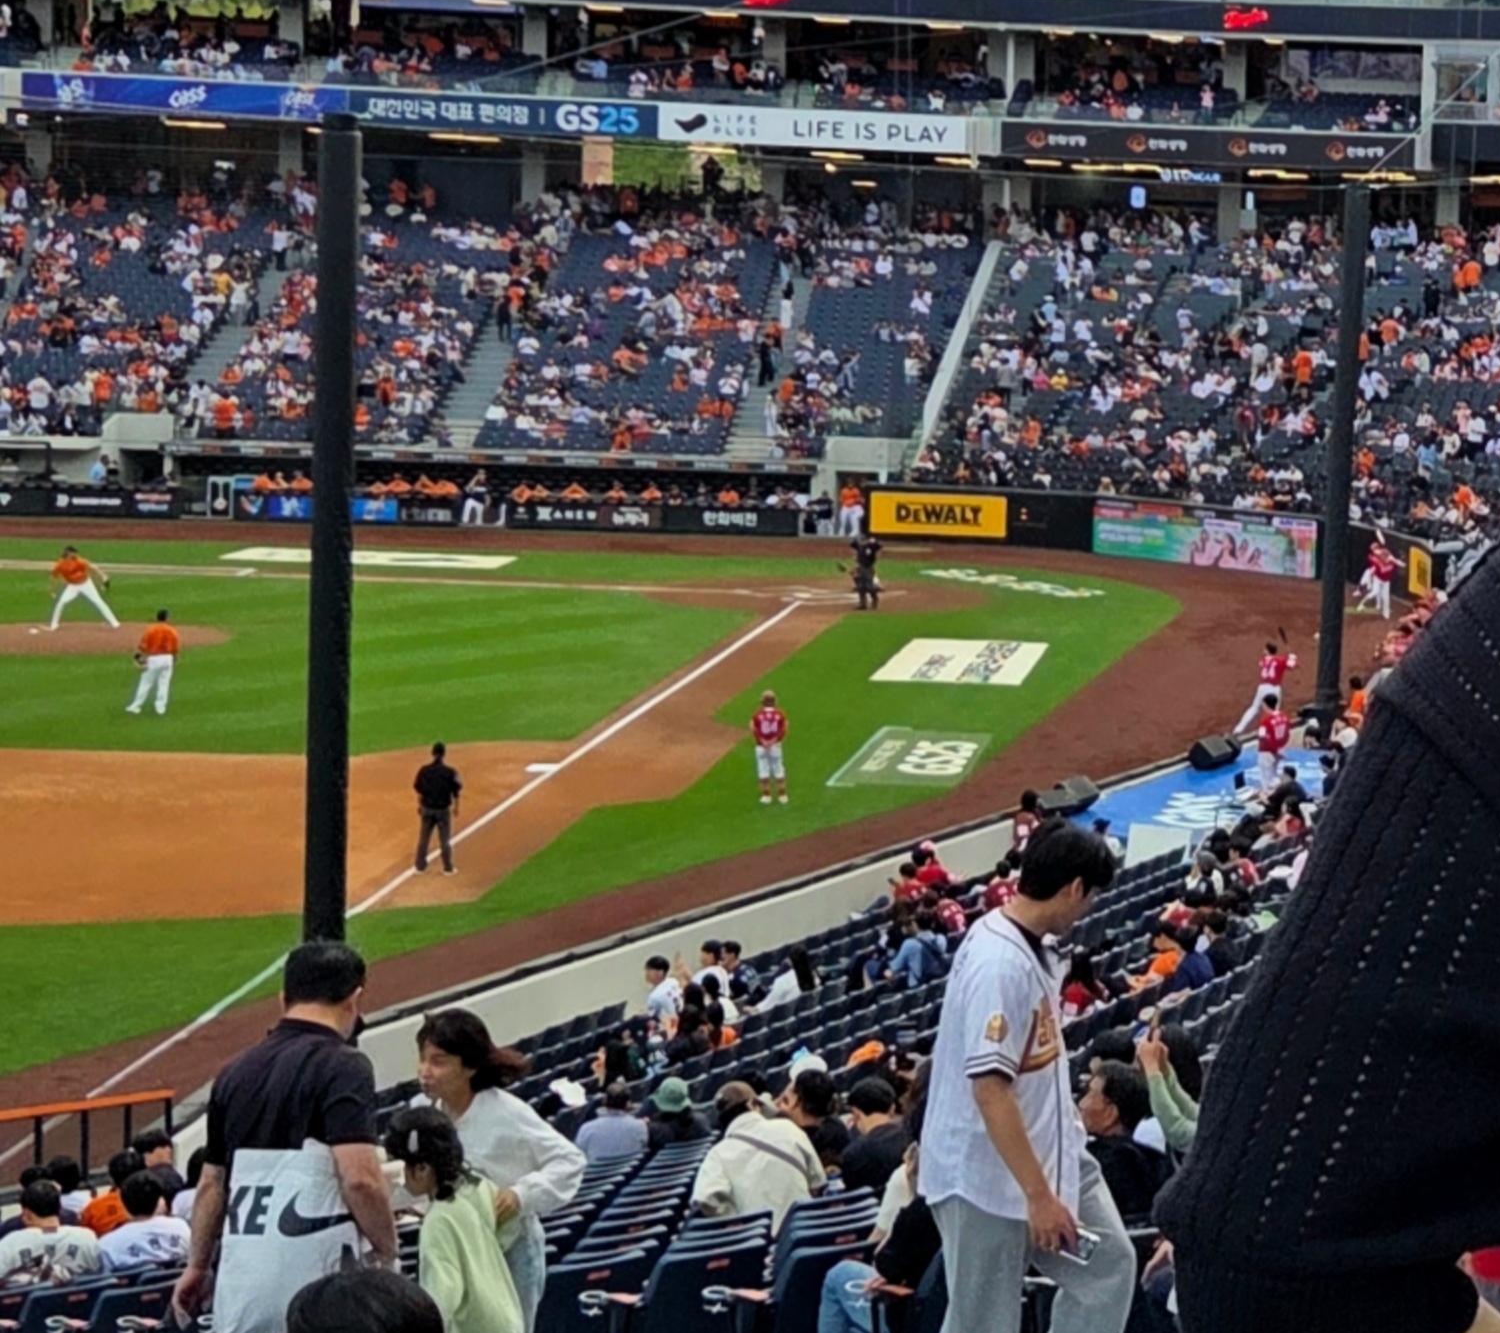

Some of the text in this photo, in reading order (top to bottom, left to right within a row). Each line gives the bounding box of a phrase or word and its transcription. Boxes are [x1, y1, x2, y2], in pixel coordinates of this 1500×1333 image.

[368, 97, 530, 125] 대한민국 대표 편의점
[555, 104, 641, 134] GS25
[793, 120, 949, 144] LIFE IS PLAY
[896, 503, 983, 526] DEWALT
